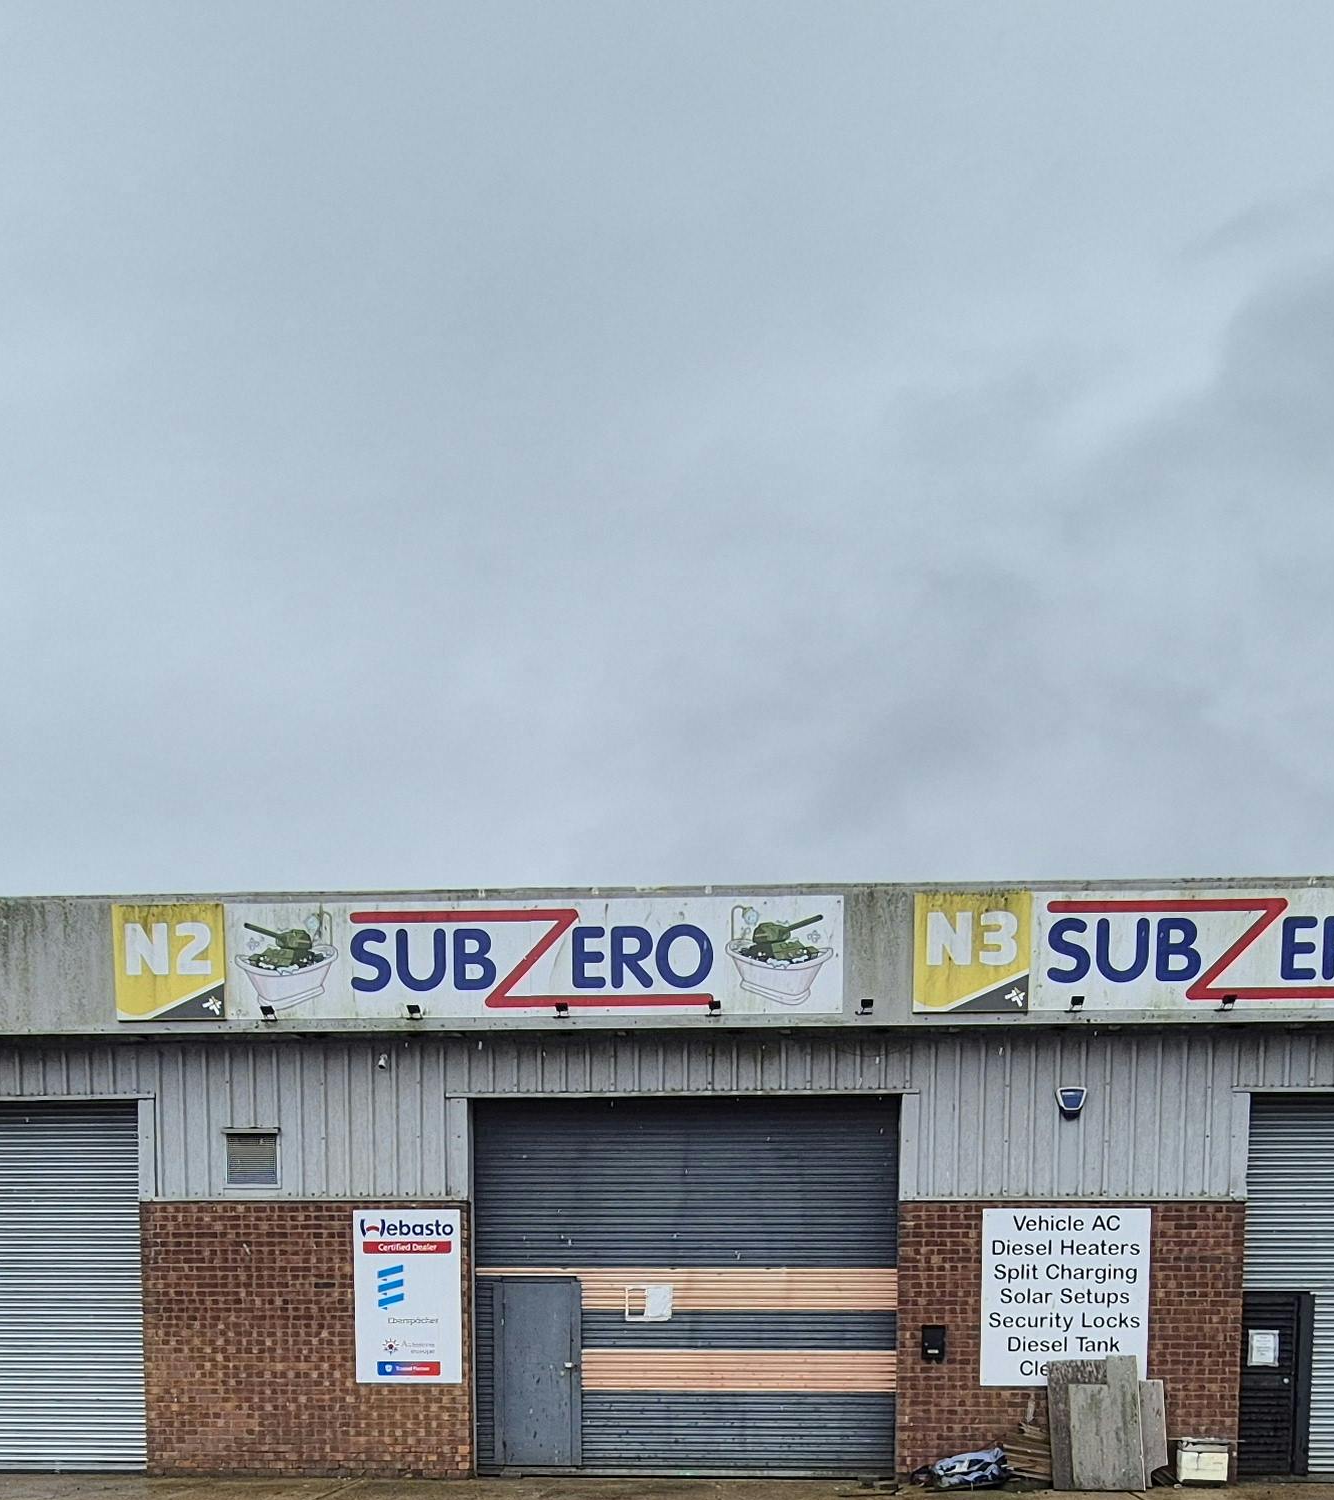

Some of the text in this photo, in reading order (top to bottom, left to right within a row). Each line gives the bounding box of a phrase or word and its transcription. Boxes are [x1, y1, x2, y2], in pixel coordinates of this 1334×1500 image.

[925, 910, 1018, 967] N3
[124, 921, 213, 977] N2
[359, 1218, 455, 1238] Webasto
[1012, 1214, 1121, 1232] Vehicle AC
[377, 1243, 438, 1252] Certified Dealer
[991, 1239, 1141, 1256] Diesel Heaters
[993, 1263, 1138, 1284] Split Charging
[1000, 1287, 1130, 1308] Solar Setups
[988, 1311, 1141, 1332] Security Locks
[1007, 1336, 1121, 1352] Diesel Tank
